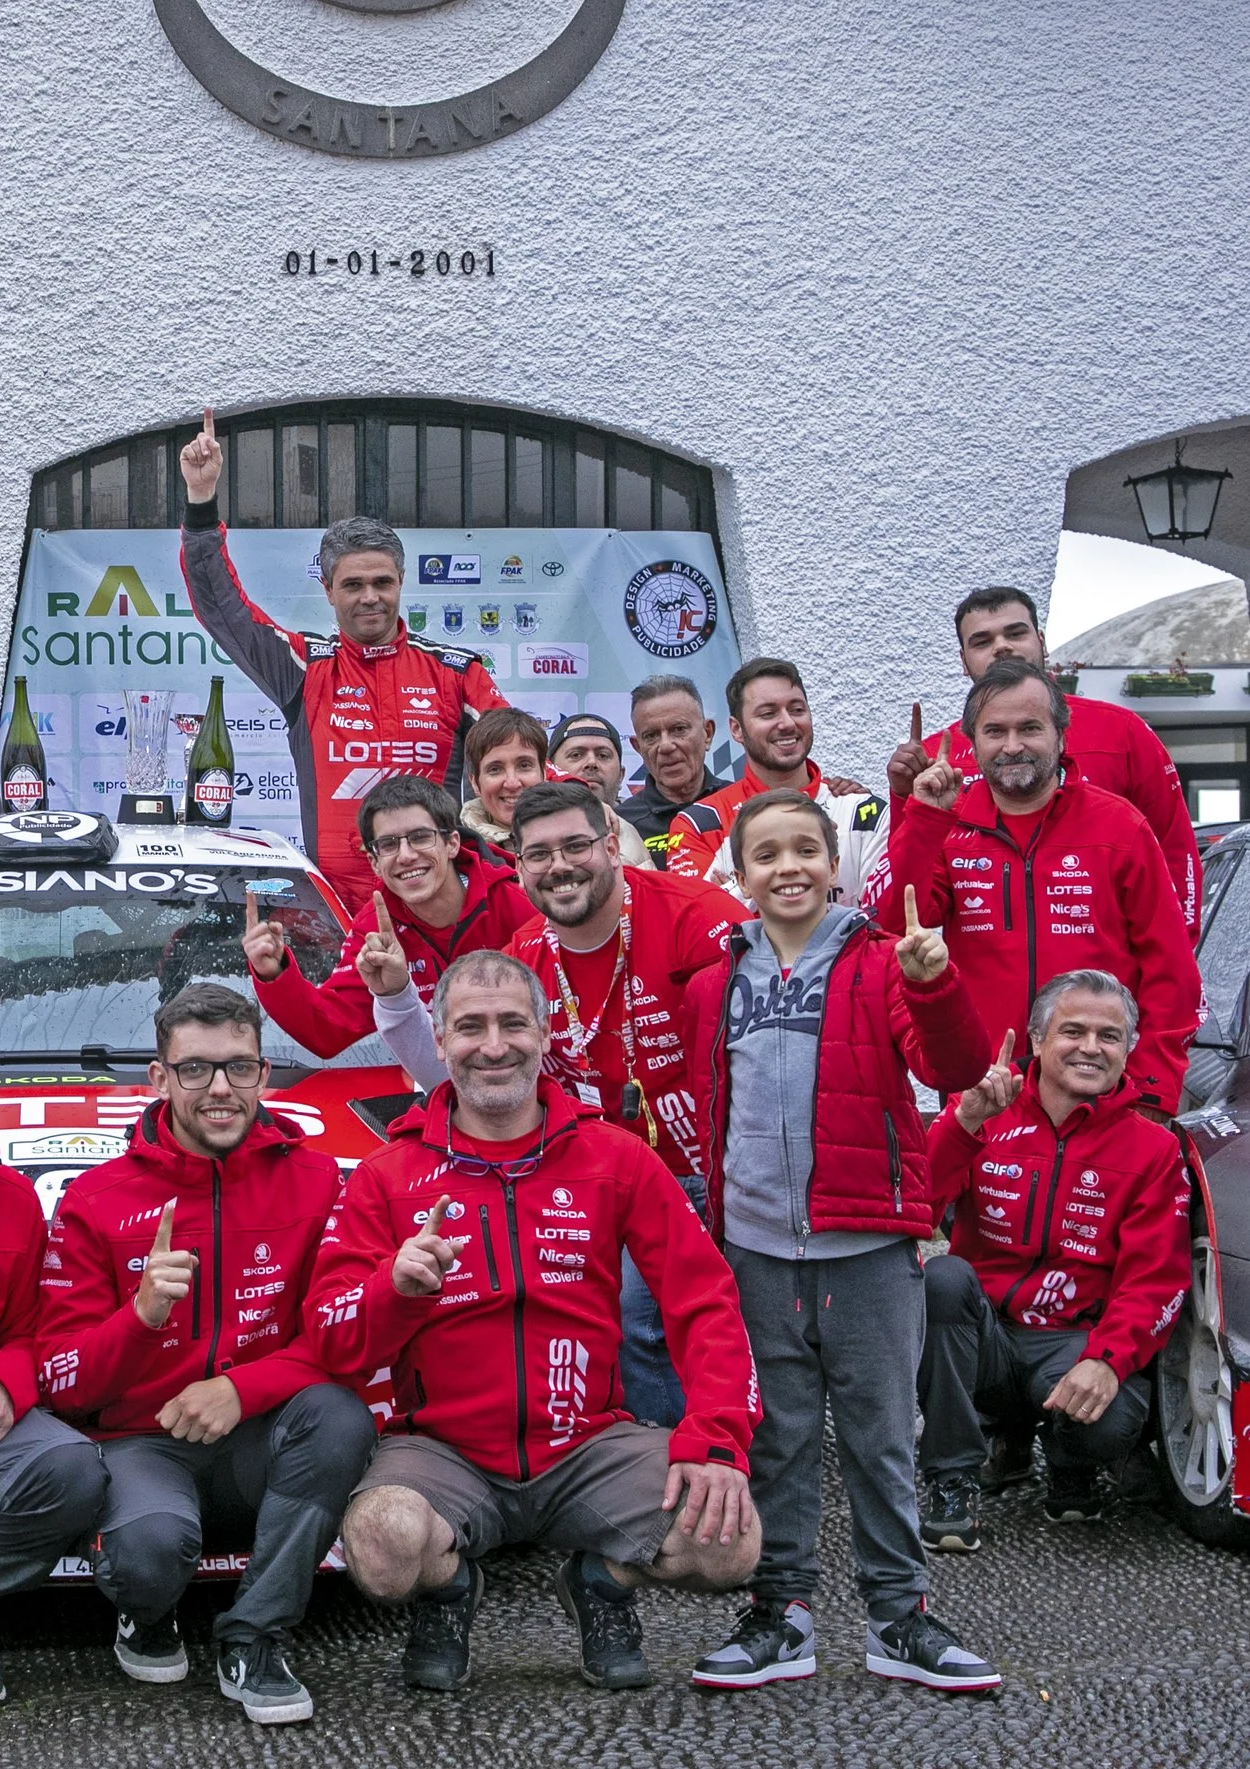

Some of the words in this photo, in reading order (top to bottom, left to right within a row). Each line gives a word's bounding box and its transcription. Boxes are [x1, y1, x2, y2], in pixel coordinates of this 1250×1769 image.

[258, 87, 524, 151] SANTANA
[286, 250, 496, 277] 01-01-2001
[500, 567, 523, 575] FPAK
[48, 565, 195, 617] RAL
[626, 567, 652, 610] DESIGN
[672, 562, 716, 622] MARKETING
[632, 625, 706, 657] PUBLICIDADE
[443, 654, 467, 665] OMP
[533, 660, 578, 675] CORAL
[401, 686, 437, 694] LOTES
[328, 741, 438, 764] LOTES
[259, 771, 298, 787] elect
[7, 783, 41, 797] CORAL
[199, 786, 231, 799] CORAL
[259, 788, 292, 801] som
[20, 815, 75, 825] NP
[139, 844, 177, 852] 100
[951, 857, 977, 870] elf
[953, 880, 995, 890] virtualcar
[1046, 885, 1093, 895] LOTES
[1185, 853, 1196, 926] virtualcar
[707, 920, 730, 938] CIAM
[634, 1010, 671, 1027] OTES
[656, 1050, 685, 1068] Dier
[981, 1160, 1008, 1176] elf
[978, 1185, 1021, 1201] virtualcar
[1072, 1186, 1106, 1199] SKODA
[541, 1208, 587, 1219] SKODA
[1066, 1202, 1106, 1217] LOTES
[535, 1227, 591, 1241] LOTES
[242, 1264, 282, 1277] SKODA
[235, 1281, 285, 1300] LOTES
[547, 1338, 574, 1447] LOTES
